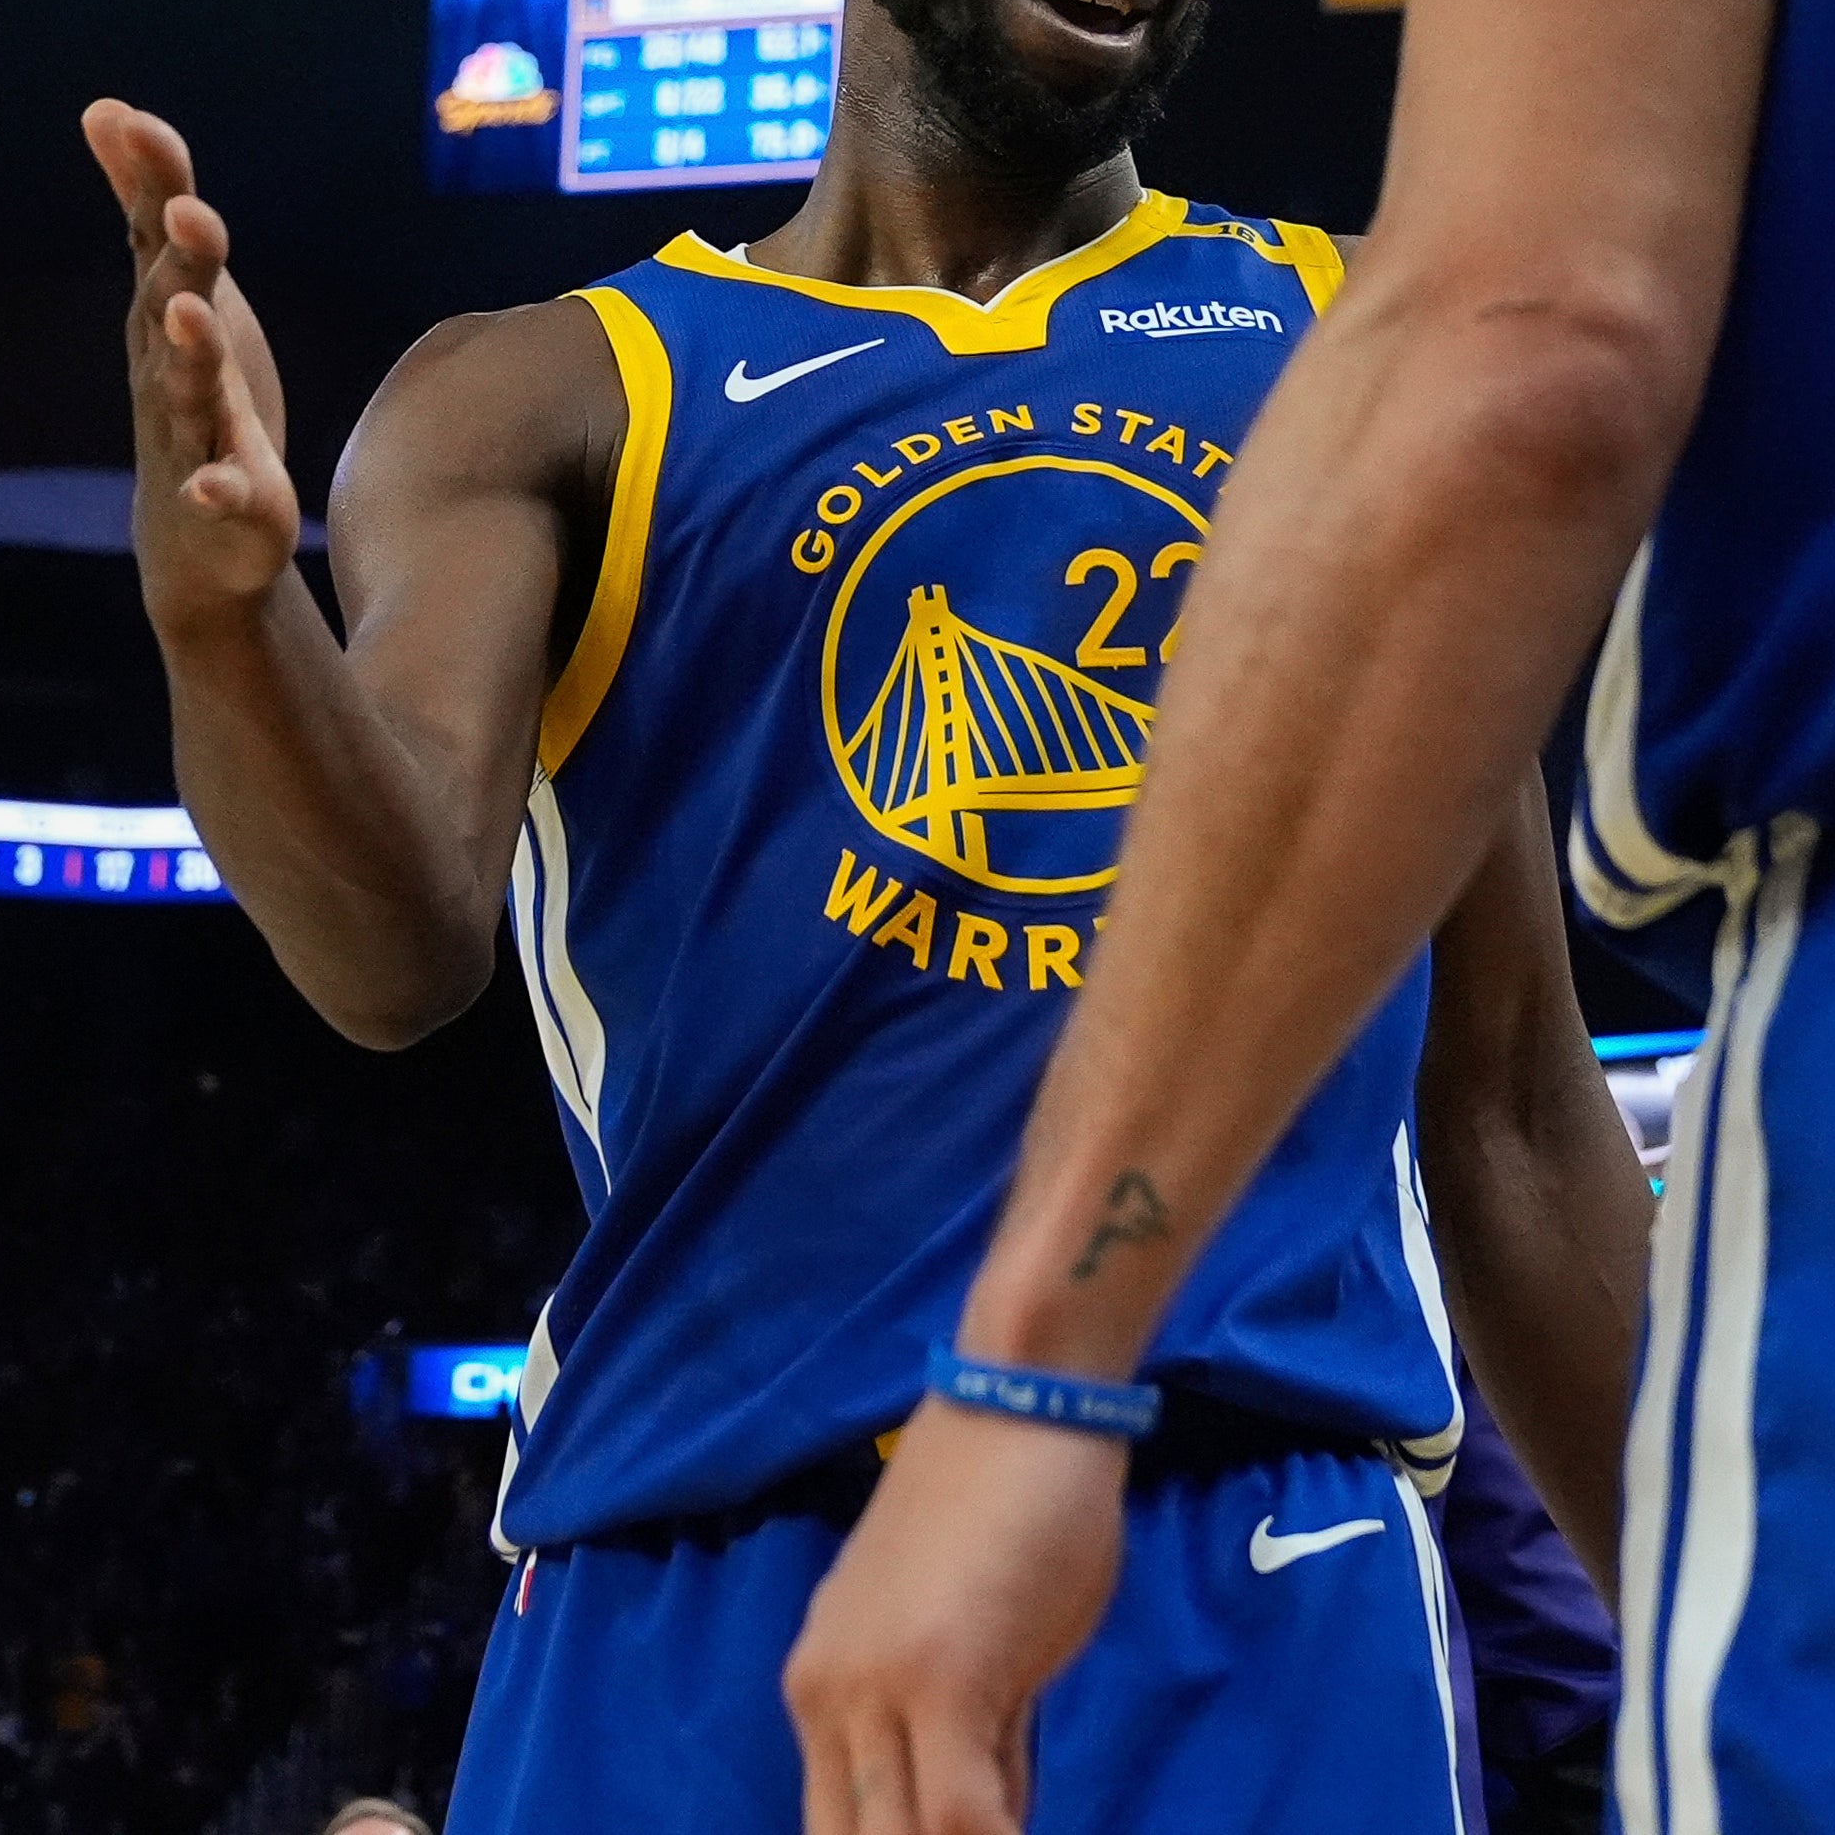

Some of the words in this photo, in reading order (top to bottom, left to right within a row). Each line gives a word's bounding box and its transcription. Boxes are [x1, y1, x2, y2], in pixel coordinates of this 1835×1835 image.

[1218, 224, 1256, 244] 16
[1099, 301, 1284, 338] Rakuten
[790, 403, 1036, 575] GOLDEN
[1070, 402, 1236, 495] STAT
[824, 848, 1108, 991] WARR
